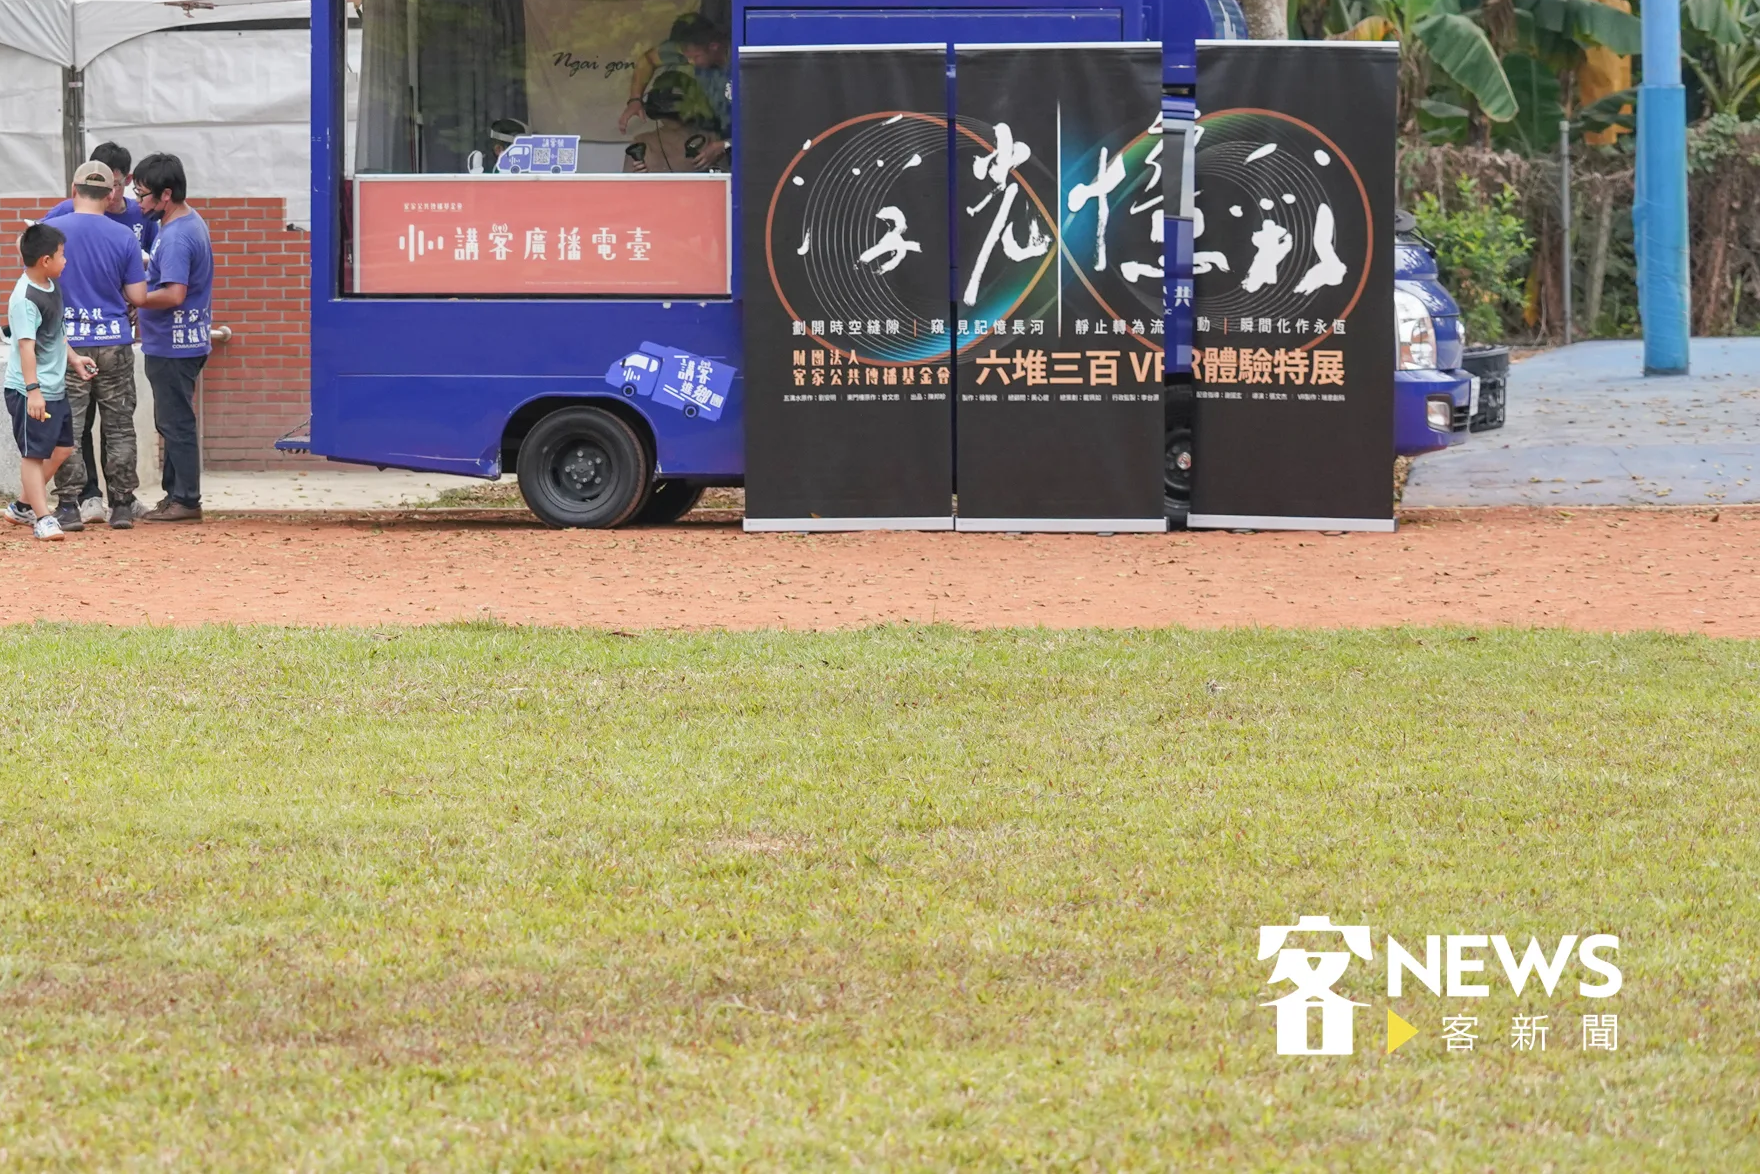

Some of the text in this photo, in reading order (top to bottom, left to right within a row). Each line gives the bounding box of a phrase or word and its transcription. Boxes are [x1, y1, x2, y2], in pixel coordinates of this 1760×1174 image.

[454, 225, 652, 261] 講客廣播電臺
[792, 349, 860, 367] 財團法人
[792, 366, 951, 387] 客家公共傳播基金會
